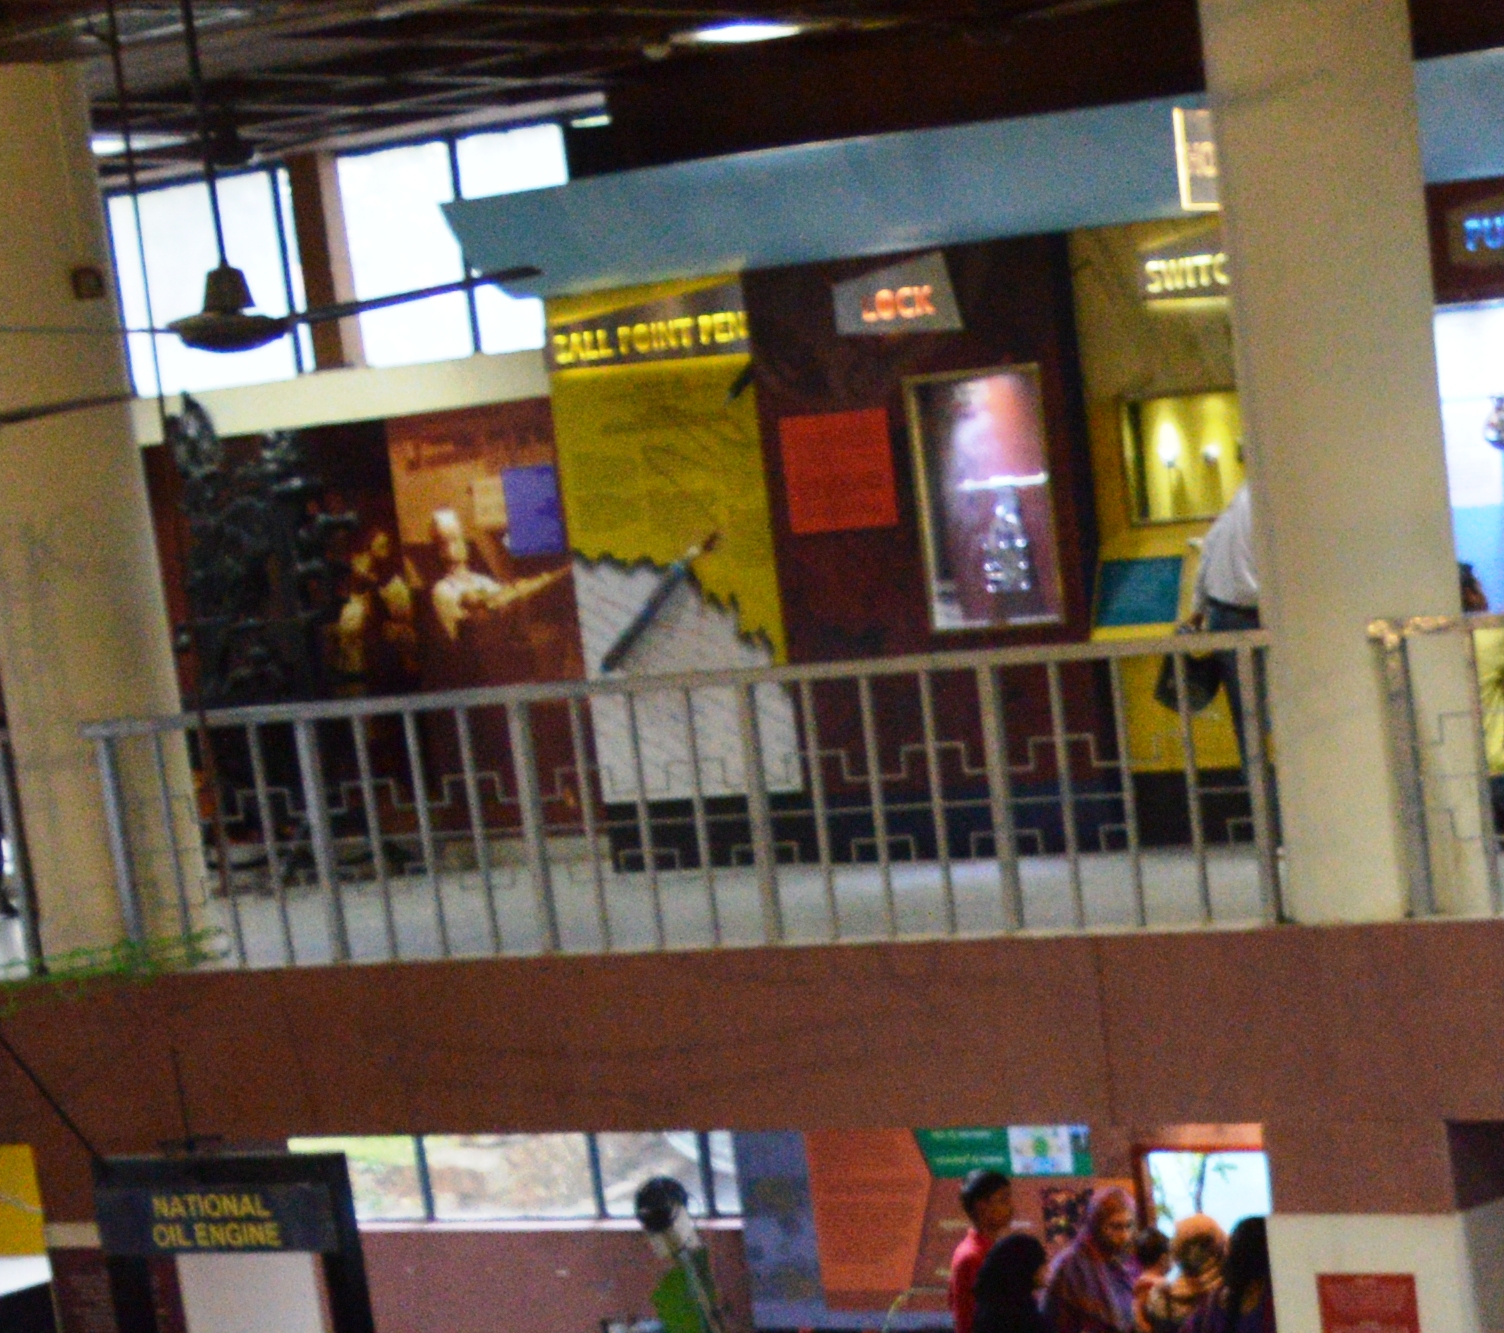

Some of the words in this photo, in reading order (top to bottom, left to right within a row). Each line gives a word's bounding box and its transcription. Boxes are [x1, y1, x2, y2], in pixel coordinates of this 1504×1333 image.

[862, 285, 937, 323] LOCK
[617, 317, 692, 355] POINT
[152, 1193, 272, 1219] NATIONAL
[152, 1222, 192, 1248] OIL
[193, 1221, 282, 1248] ENGINE
